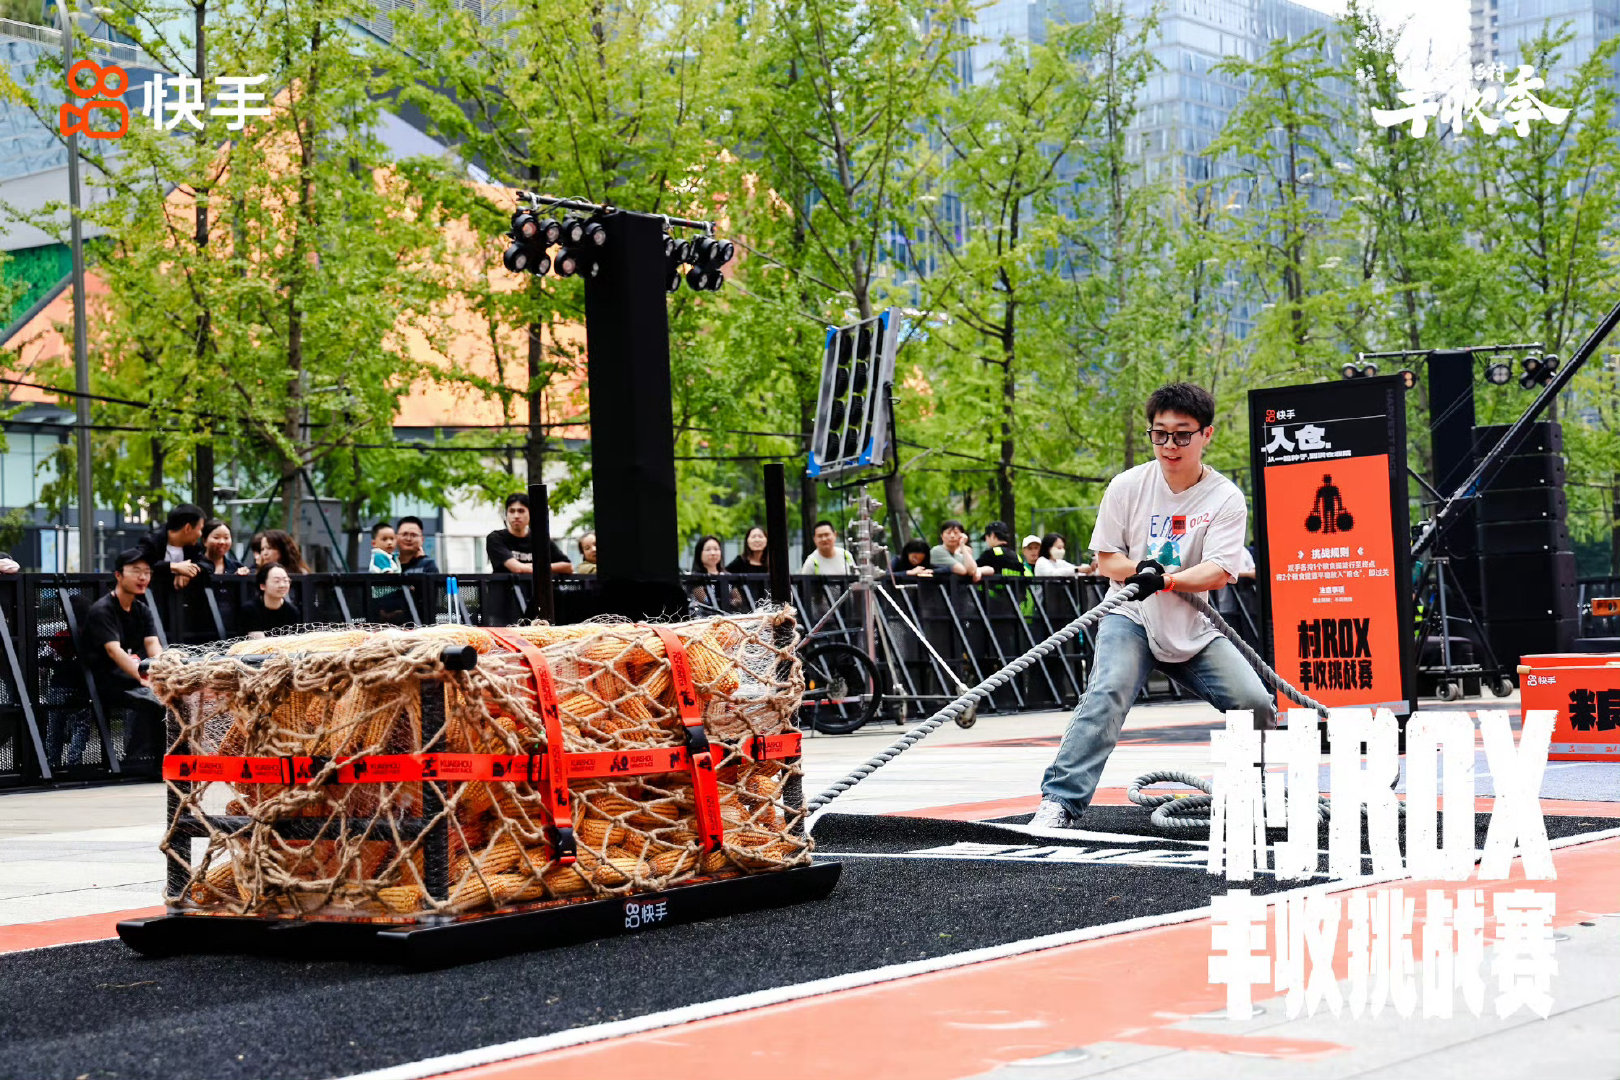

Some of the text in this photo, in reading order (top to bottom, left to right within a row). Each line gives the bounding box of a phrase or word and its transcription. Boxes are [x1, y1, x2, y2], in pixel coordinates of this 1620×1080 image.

[1276, 409, 1296, 421] 快手
[1312, 547, 1350, 560] 挑战规则
[1297, 618, 1372, 659] 村ROX
[1299, 659, 1373, 691] 丰收挑战赛
[1538, 676, 1557, 685] 快手
[440, 760, 473, 768] KUAISHOU
[641, 901, 668, 924] 快手
